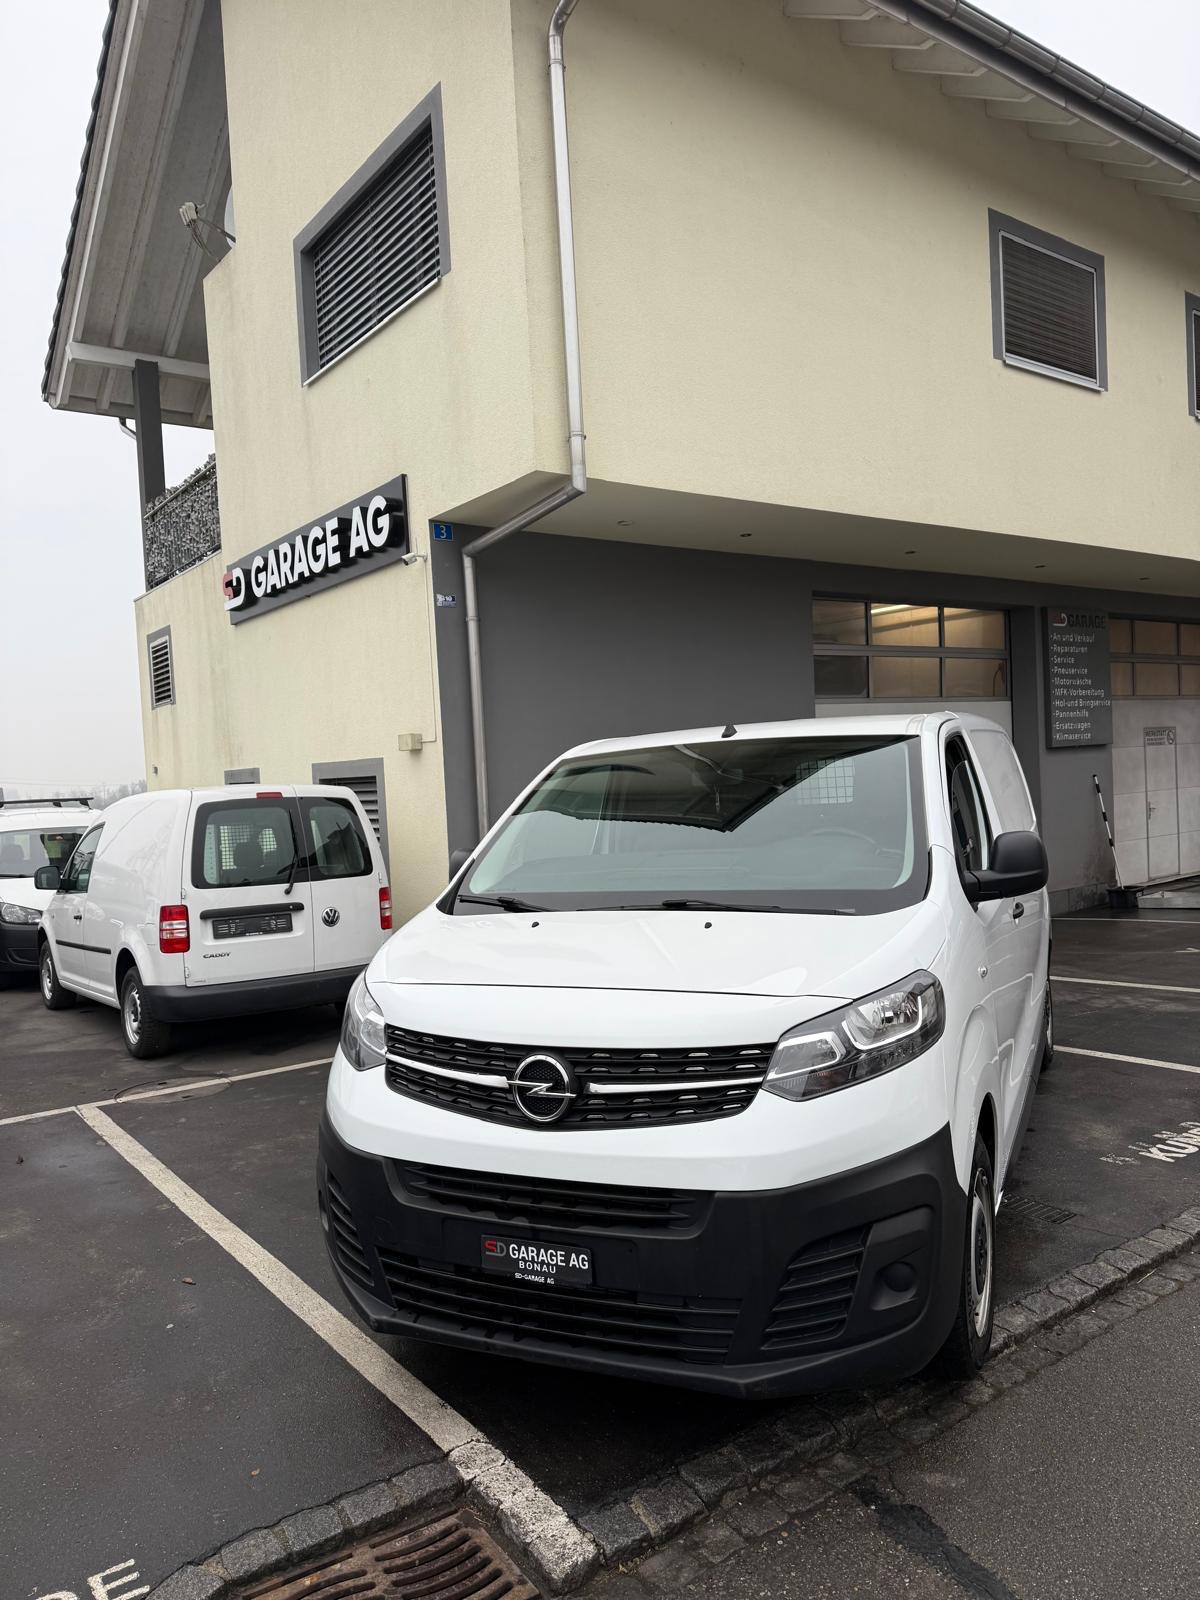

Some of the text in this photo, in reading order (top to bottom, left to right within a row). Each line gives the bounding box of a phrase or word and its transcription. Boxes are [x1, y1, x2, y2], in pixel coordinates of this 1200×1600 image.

[440, 525, 447, 538] 3
[251, 517, 341, 598] GARAGE
[349, 495, 390, 558] AG
[1068, 613, 1105, 629] GARAGE
[1074, 632, 1095, 643] Verkauf
[1053, 644, 1088, 655] Reparaturen
[1053, 655, 1075, 664] Service
[1054, 666, 1088, 675] Pneuservice
[1055, 709, 1089, 718] Pannenhilfe
[1055, 720, 1091, 731] Ersatzwagen
[1056, 732, 1092, 741] Klimaservice
[202, 951, 232, 959] CADDY
[509, 1243, 566, 1266] GARAGE
[569, 1252, 589, 1270] AG
[518, 1260, 556, 1274] BONAU
